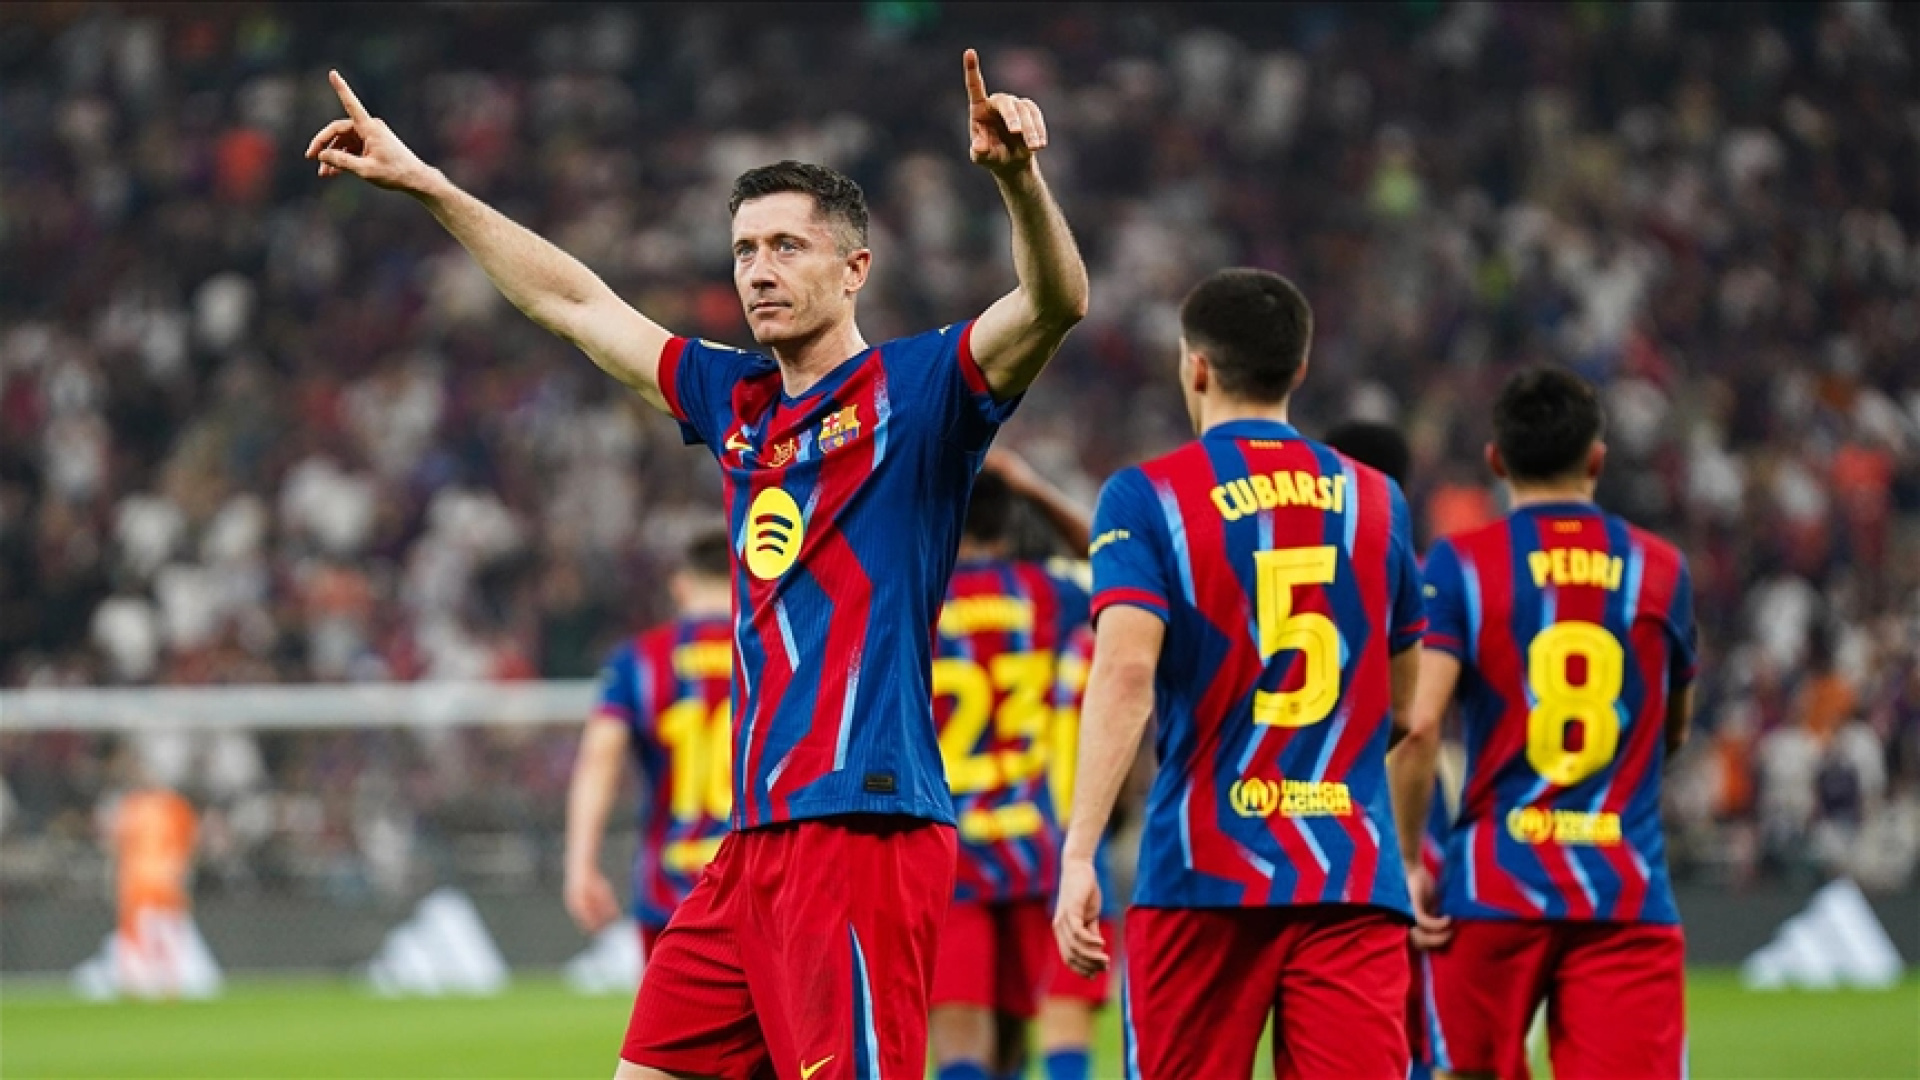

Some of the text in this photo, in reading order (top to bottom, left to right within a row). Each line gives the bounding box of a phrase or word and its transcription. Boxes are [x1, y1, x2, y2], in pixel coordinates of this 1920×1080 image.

[1253, 546, 1338, 727] 5
[1527, 548, 1623, 591] PEDRI
[931, 649, 1053, 794] 23
[1526, 620, 1624, 786] 8
